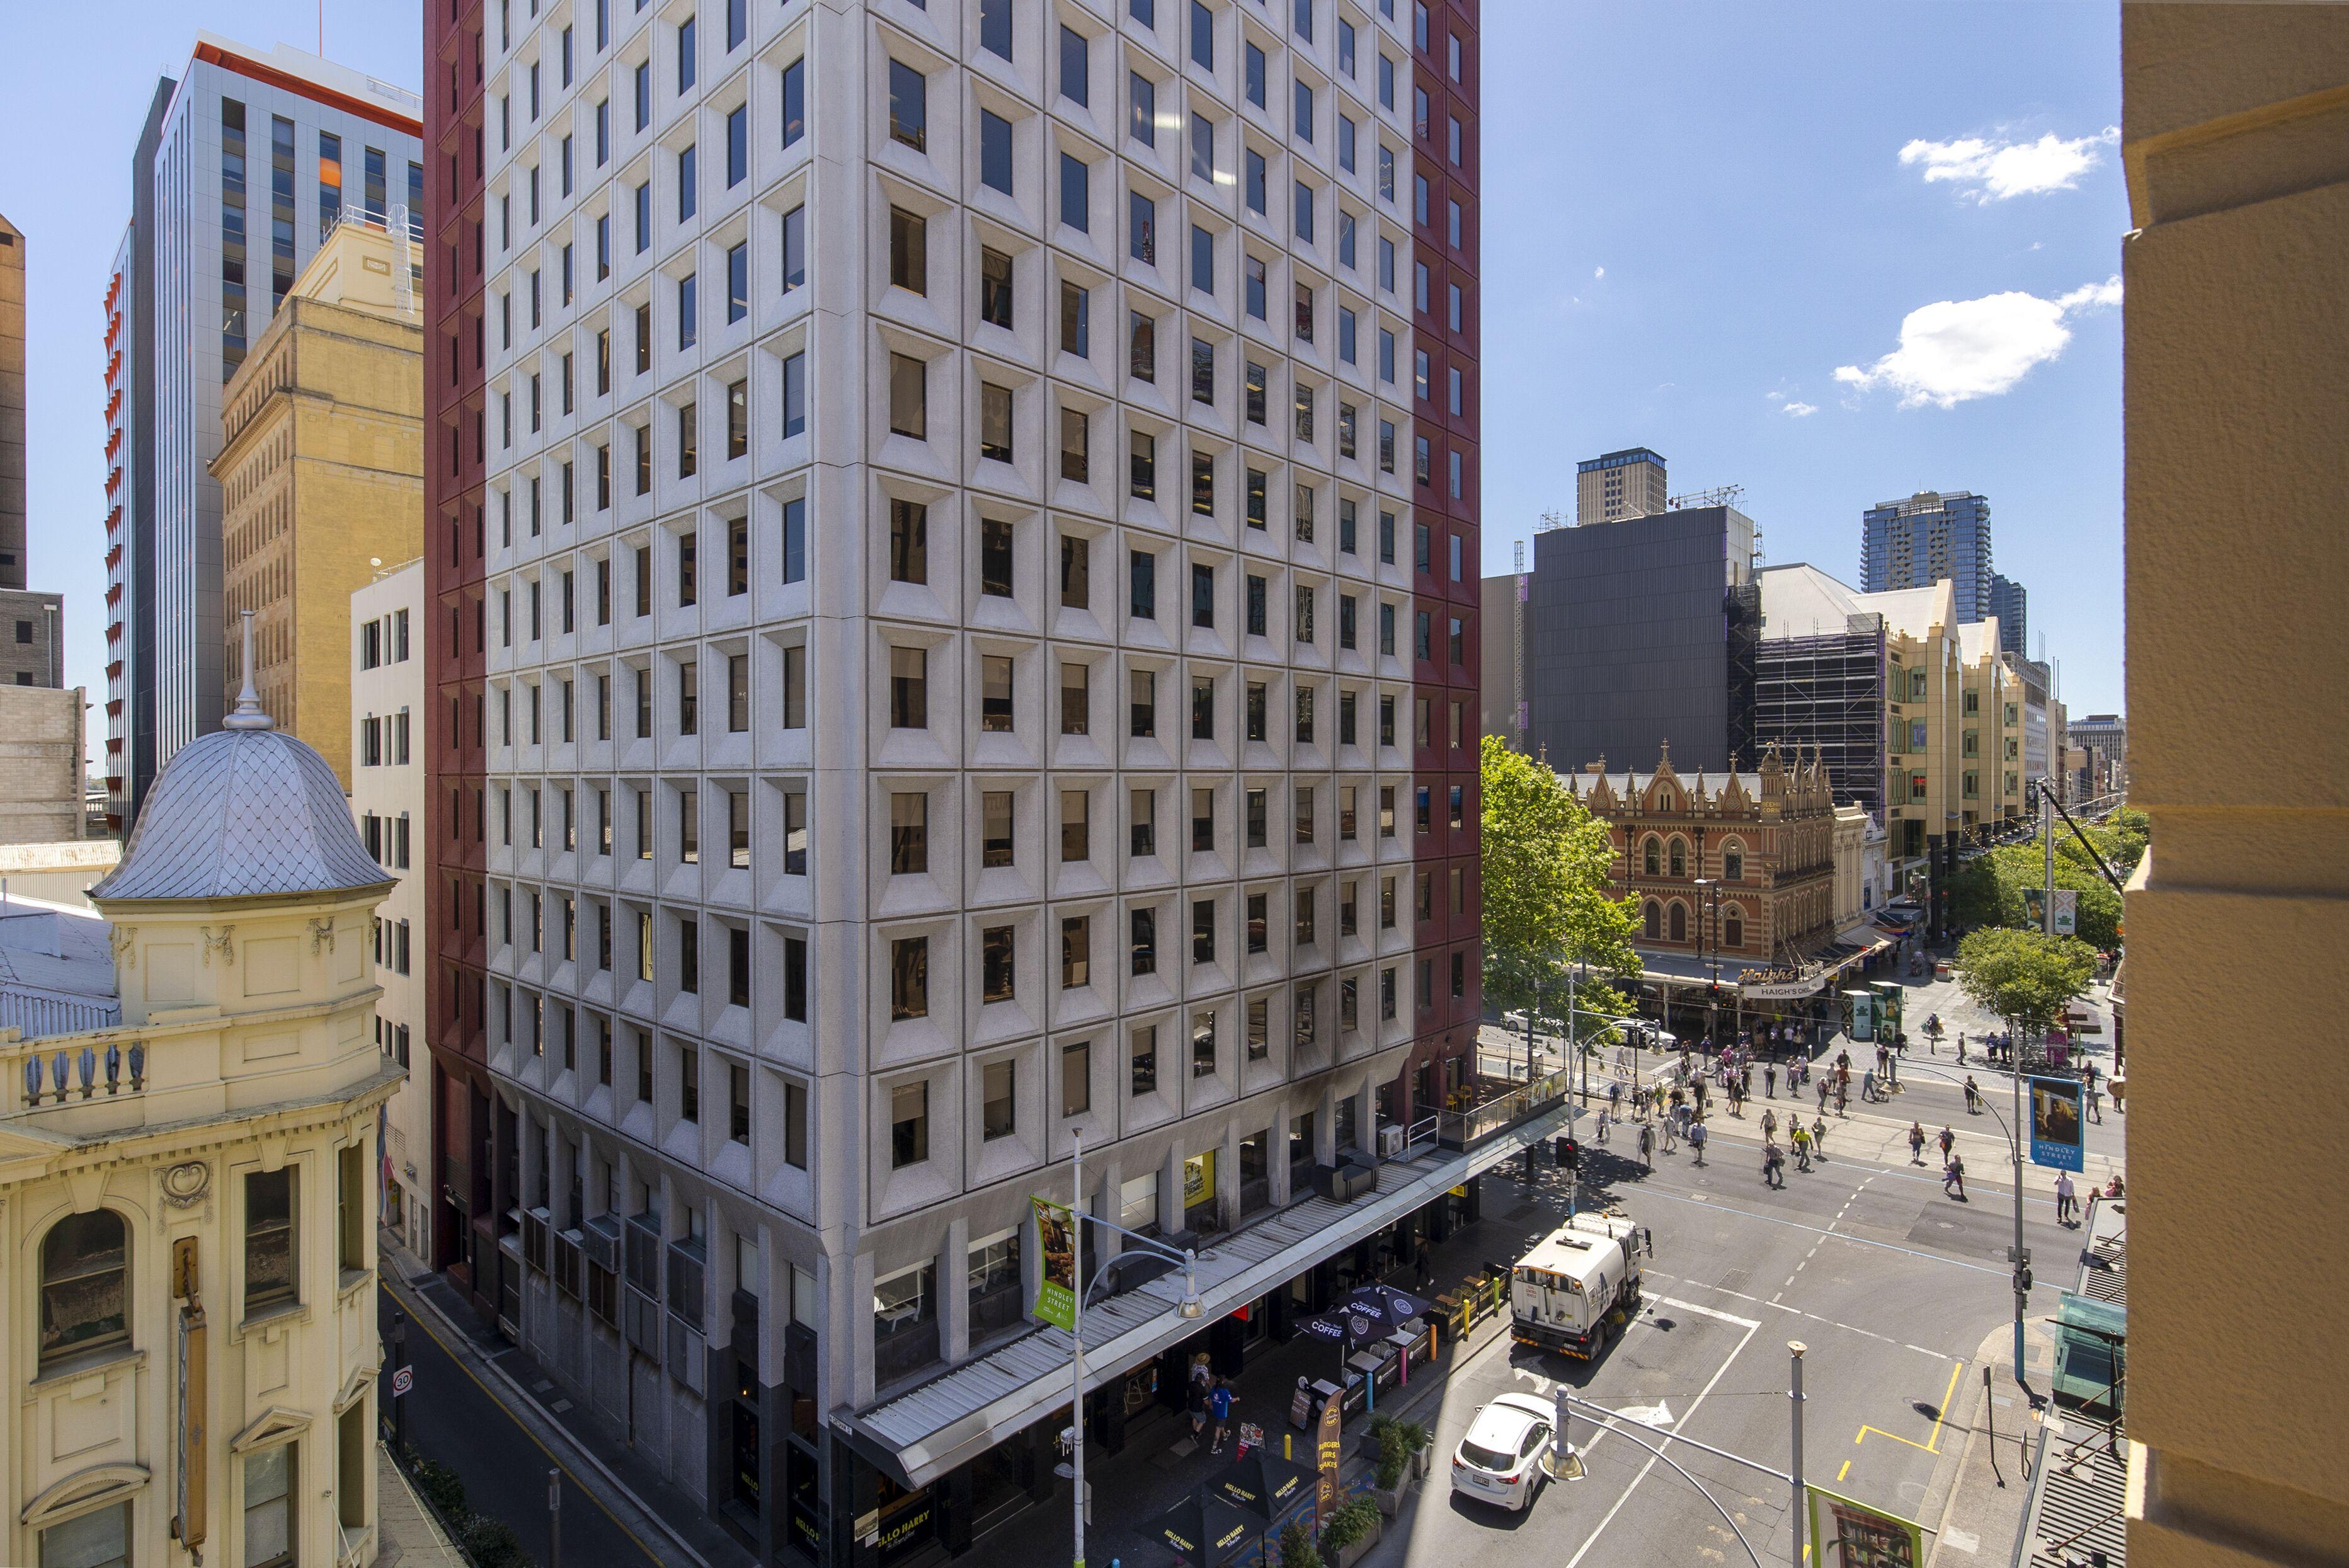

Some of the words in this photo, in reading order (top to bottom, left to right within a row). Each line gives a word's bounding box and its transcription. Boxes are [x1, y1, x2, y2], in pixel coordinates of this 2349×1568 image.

[2038, 1144, 2075, 1155] HINDLEY
[2041, 1150, 2072, 1160] STREET
[1046, 1287, 1073, 1303] HINDLEY
[1047, 1296, 1070, 1312] STREET
[1351, 1302, 1382, 1319] COFFEE
[1312, 1321, 1342, 1337] COFFEE
[397, 1375, 409, 1387] 30
[1318, 1441, 1340, 1451] BURGERS
[1322, 1451, 1336, 1460] EERS
[1225, 1482, 1241, 1494] HELLO
[1240, 1489, 1256, 1501] HARRY
[1274, 1486, 1287, 1499] HELLO
[1286, 1476, 1299, 1490] HARRY
[901, 1509, 930, 1534] HARRY
[1164, 1529, 1180, 1542] HELLO
[1179, 1538, 1194, 1552] HARRY
[1216, 1535, 1231, 1549] HELLO
[1230, 1524, 1245, 1539] HARRY
